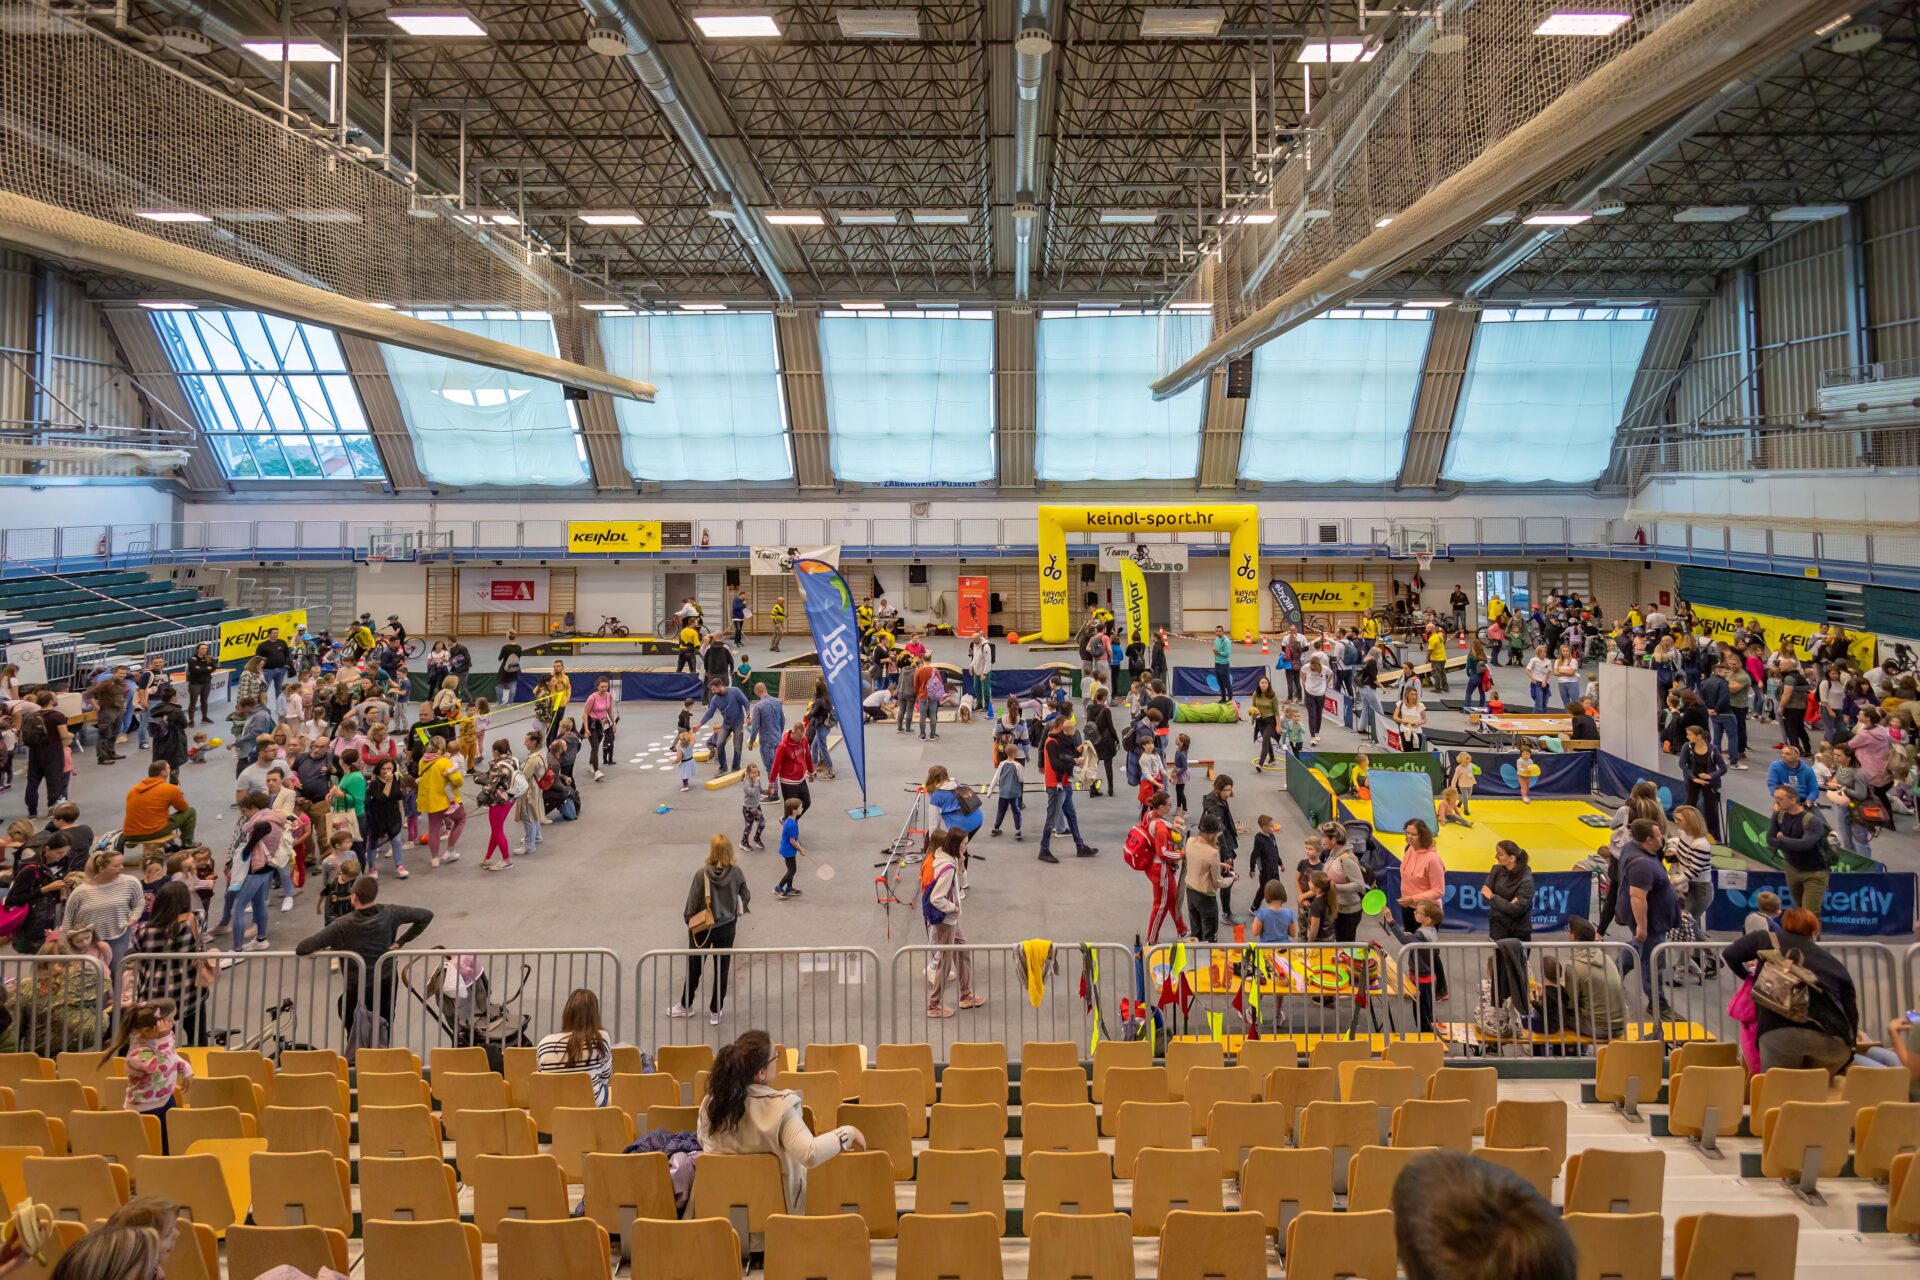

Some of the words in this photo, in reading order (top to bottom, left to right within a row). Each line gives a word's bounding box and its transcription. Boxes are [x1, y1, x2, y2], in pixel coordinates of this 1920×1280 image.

[1087, 511, 1214, 527] keindl-sport.hr
[573, 529, 629, 545] KEINDL
[755, 550, 780, 560] Team
[1105, 546, 1129, 557] Team
[1141, 563, 1184, 571] ODEO
[1697, 617, 1736, 634] KEIND
[224, 626, 270, 647] KEIND
